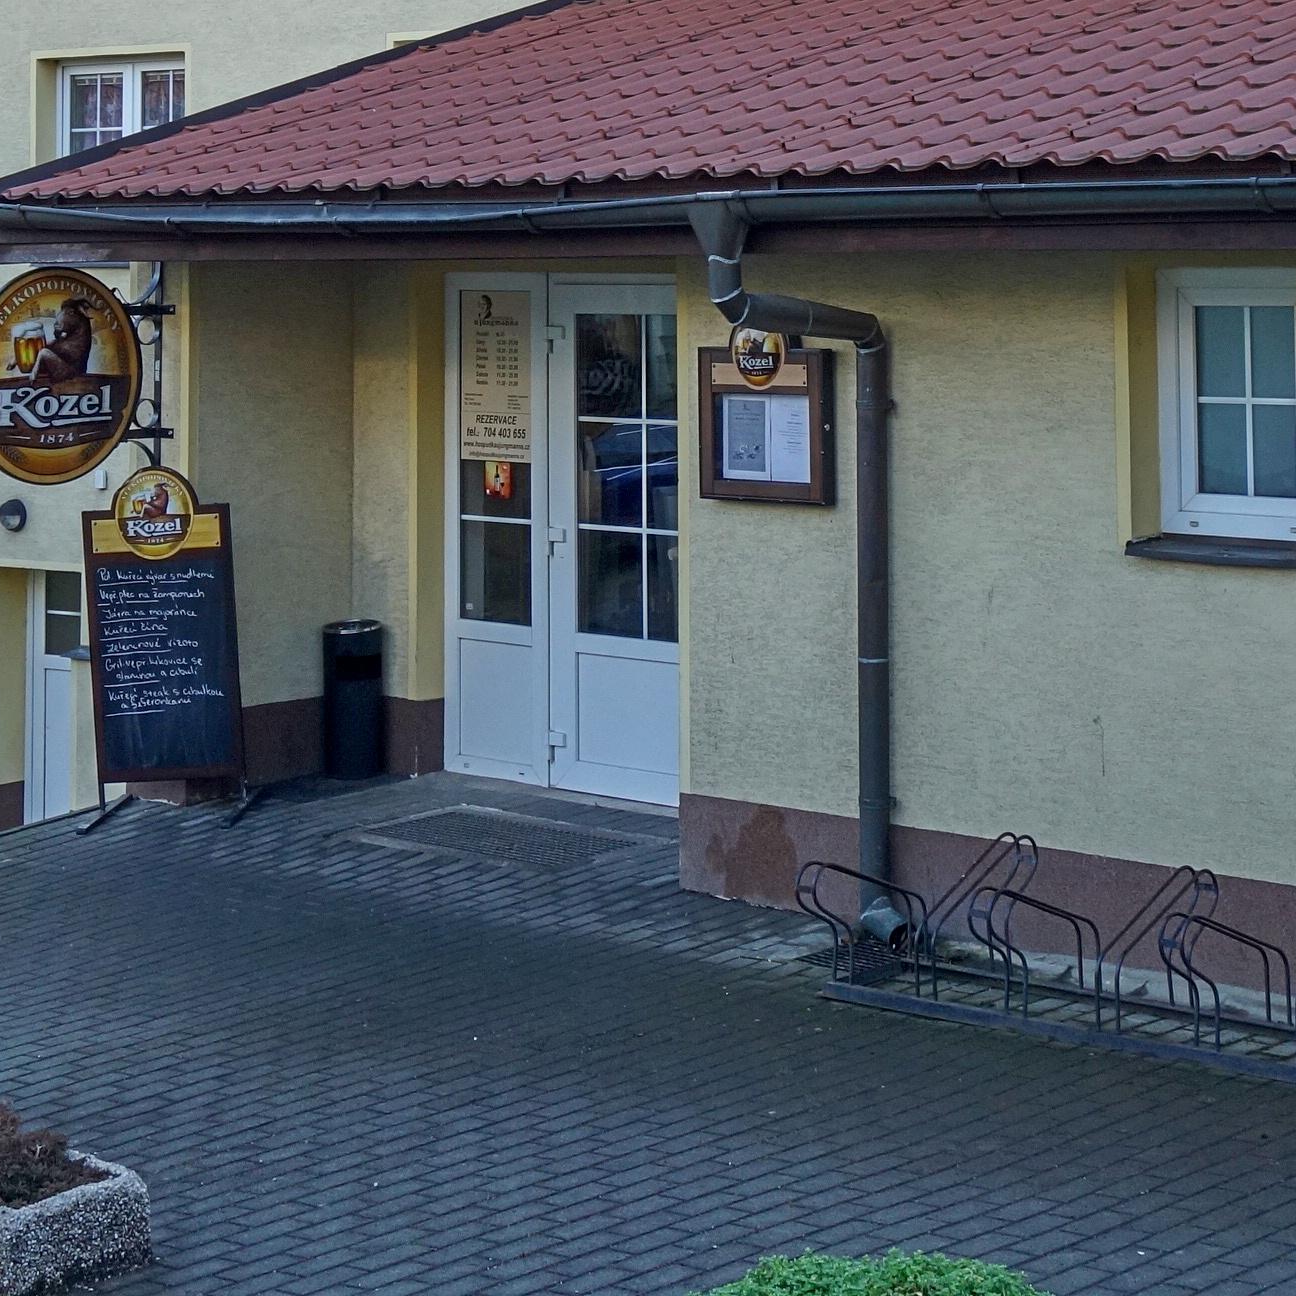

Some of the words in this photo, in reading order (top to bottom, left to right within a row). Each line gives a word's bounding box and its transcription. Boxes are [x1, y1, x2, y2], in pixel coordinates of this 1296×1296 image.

[739, 356, 774, 370] Kozel
[476, 415, 517, 425] REZERVACE
[39, 432, 74, 443] 1874
[483, 427, 496, 438] 704
[498, 428, 511, 439] 403
[513, 429, 526, 439] 655
[126, 518, 182, 537] Kozel
[104, 622, 137, 635] Kuřecí
[168, 639, 199, 648] rizoto
[191, 657, 203, 666] se
[143, 686, 169, 698] steak
[173, 688, 180, 696] s
[183, 684, 224, 697] cibulkou
